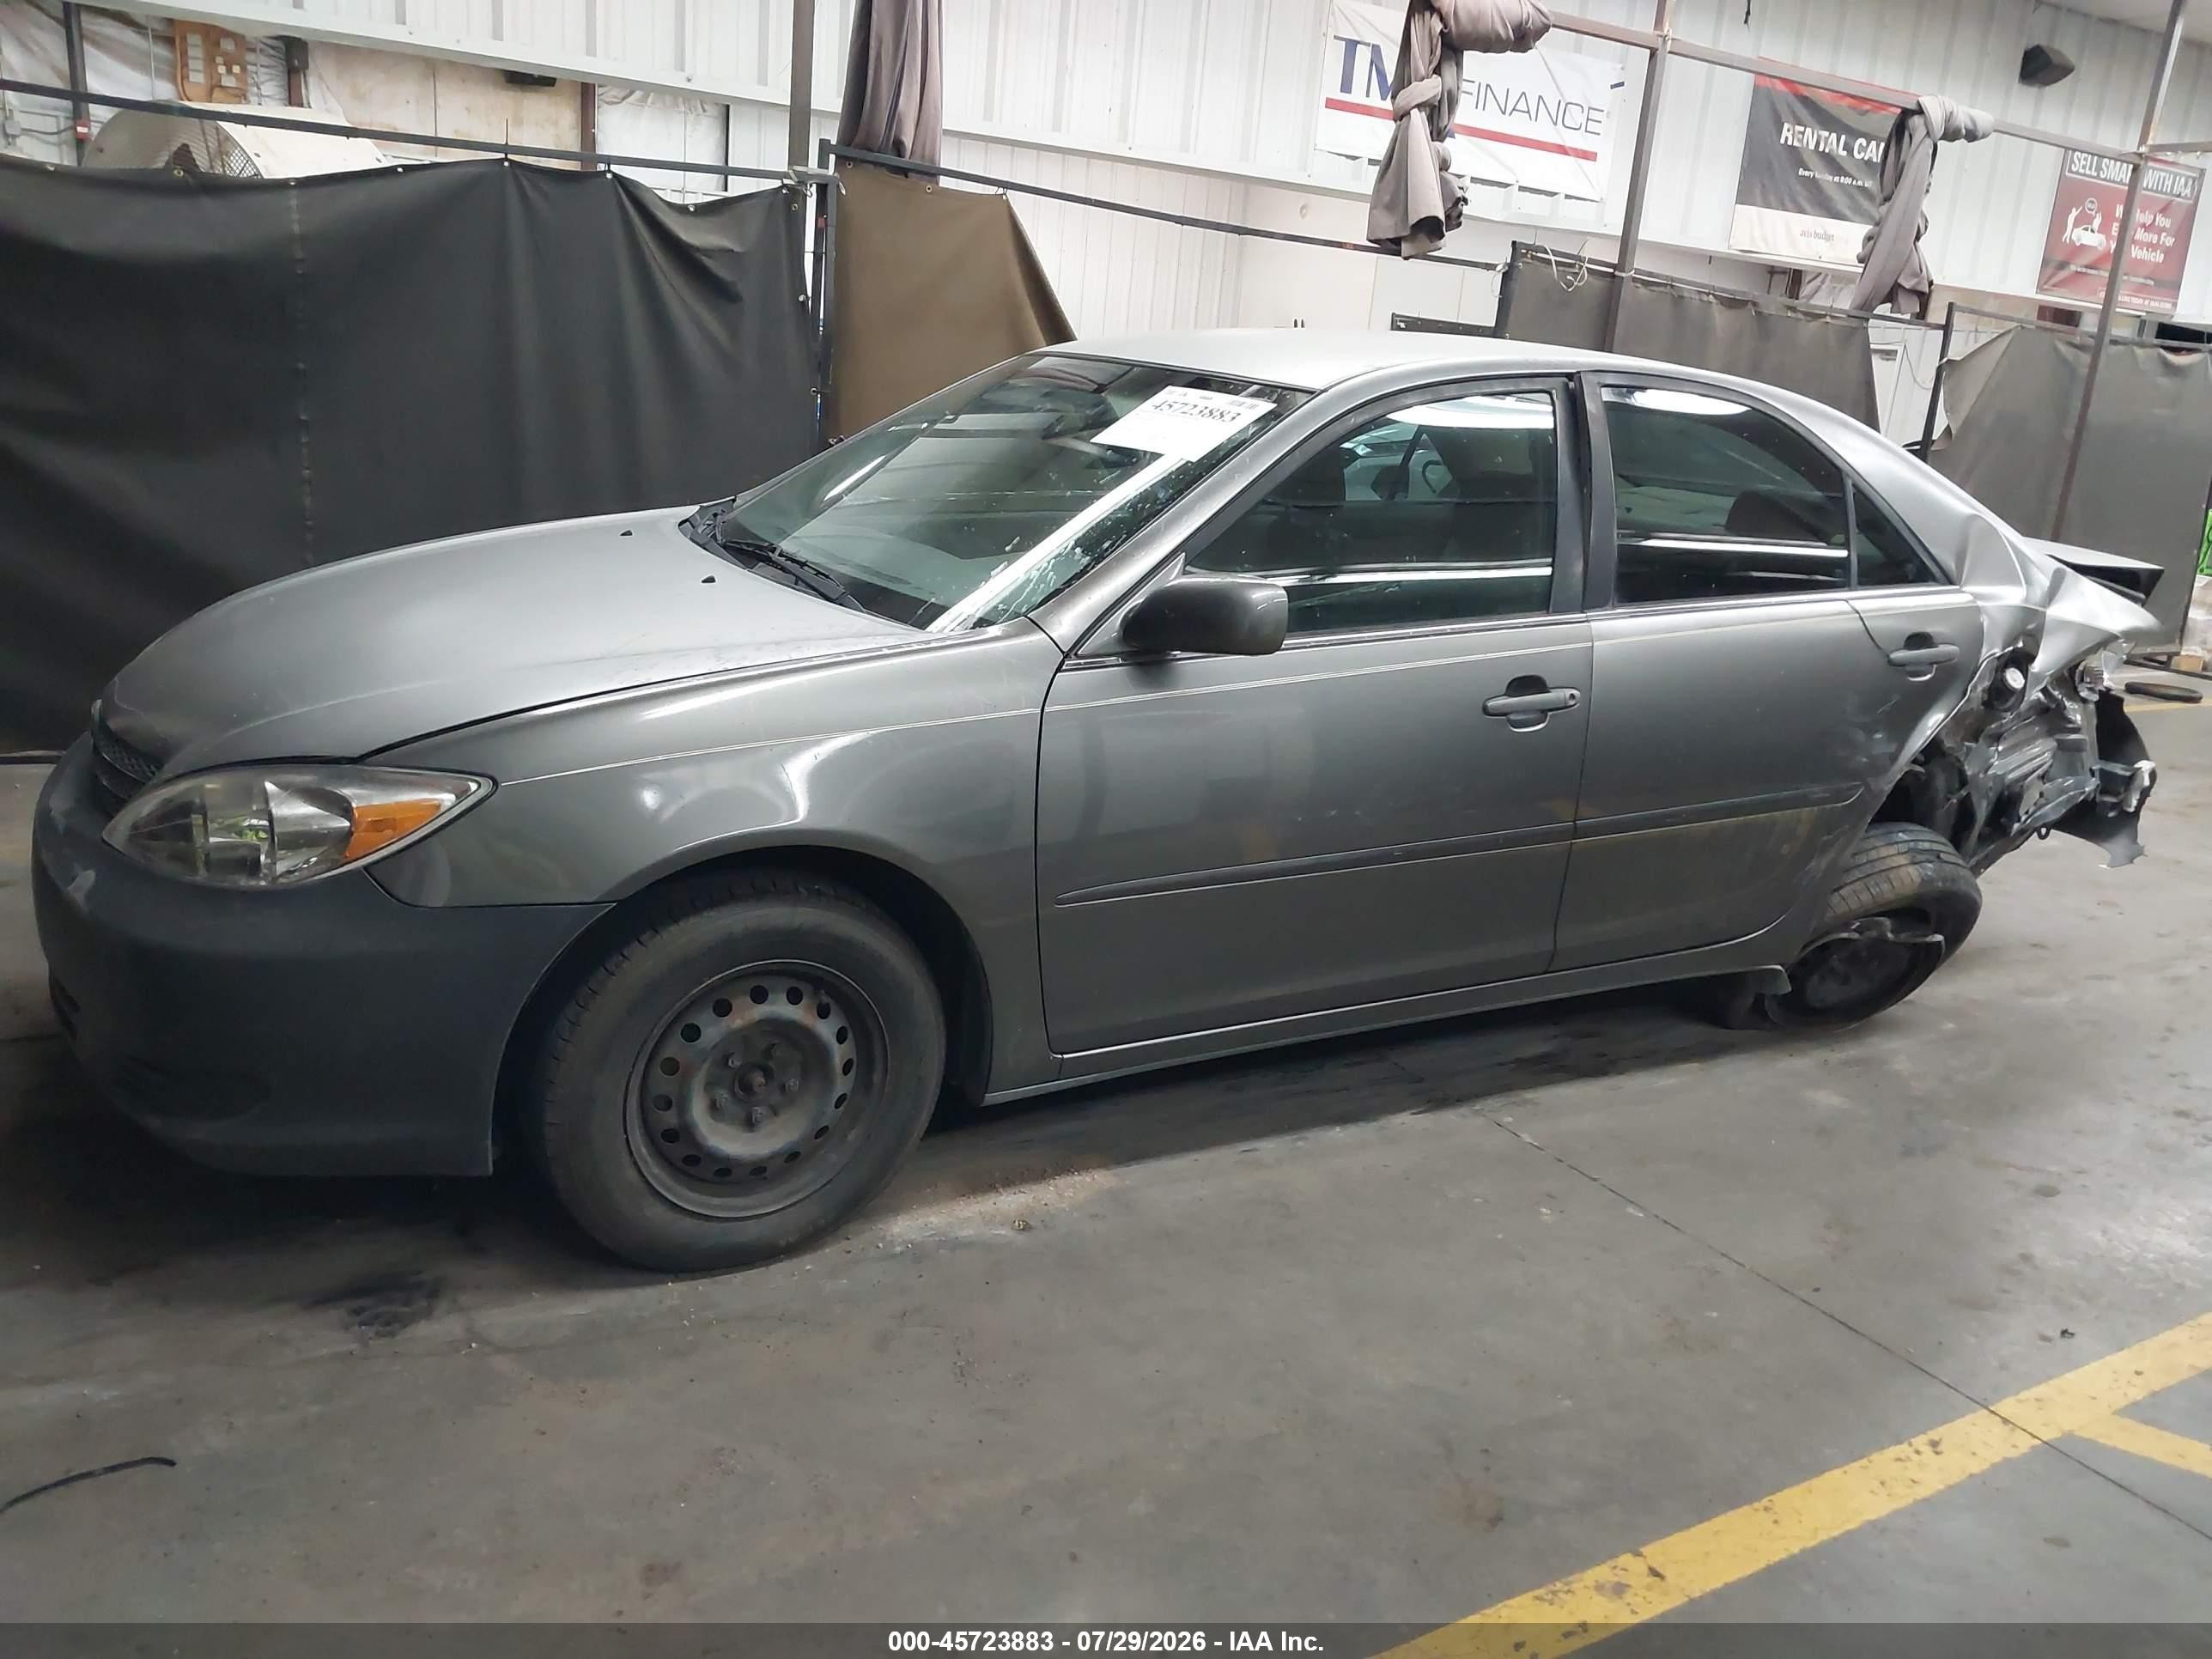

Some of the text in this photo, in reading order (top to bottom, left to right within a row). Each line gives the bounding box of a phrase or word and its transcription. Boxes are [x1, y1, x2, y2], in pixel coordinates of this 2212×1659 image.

[1780, 122, 1847, 156] RENTAL
[1798, 167, 1814, 179] Every
[2071, 151, 2098, 176] SELL
[2142, 168, 2173, 192] WITH
[2155, 212, 2172, 228] You
[2135, 227, 2158, 244] More
[2160, 232, 2175, 247] For
[2131, 244, 2165, 263] Vehicle
[1152, 399, 1242, 422] 45723883
